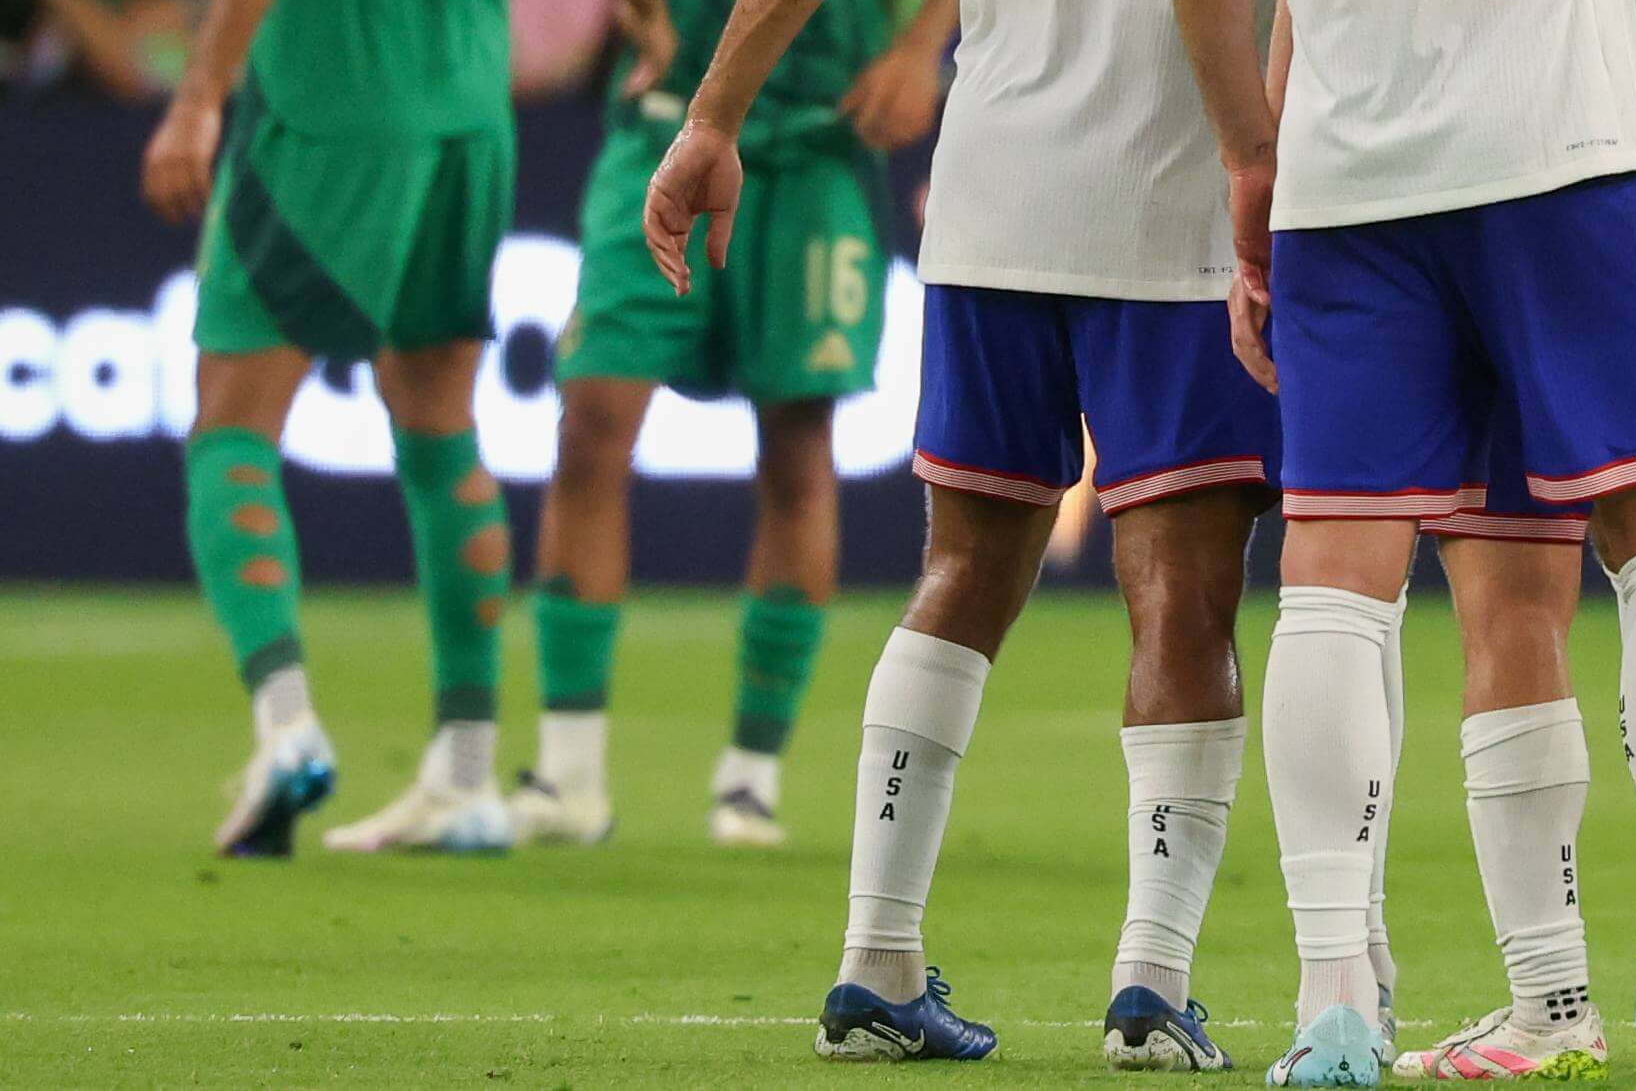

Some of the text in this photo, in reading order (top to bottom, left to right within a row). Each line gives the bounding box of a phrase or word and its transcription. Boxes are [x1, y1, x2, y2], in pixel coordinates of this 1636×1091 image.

[805, 235, 869, 326] 16
[879, 749, 910, 822] USA
[1356, 779, 1381, 842] USA
[1561, 844, 1576, 906] USA
